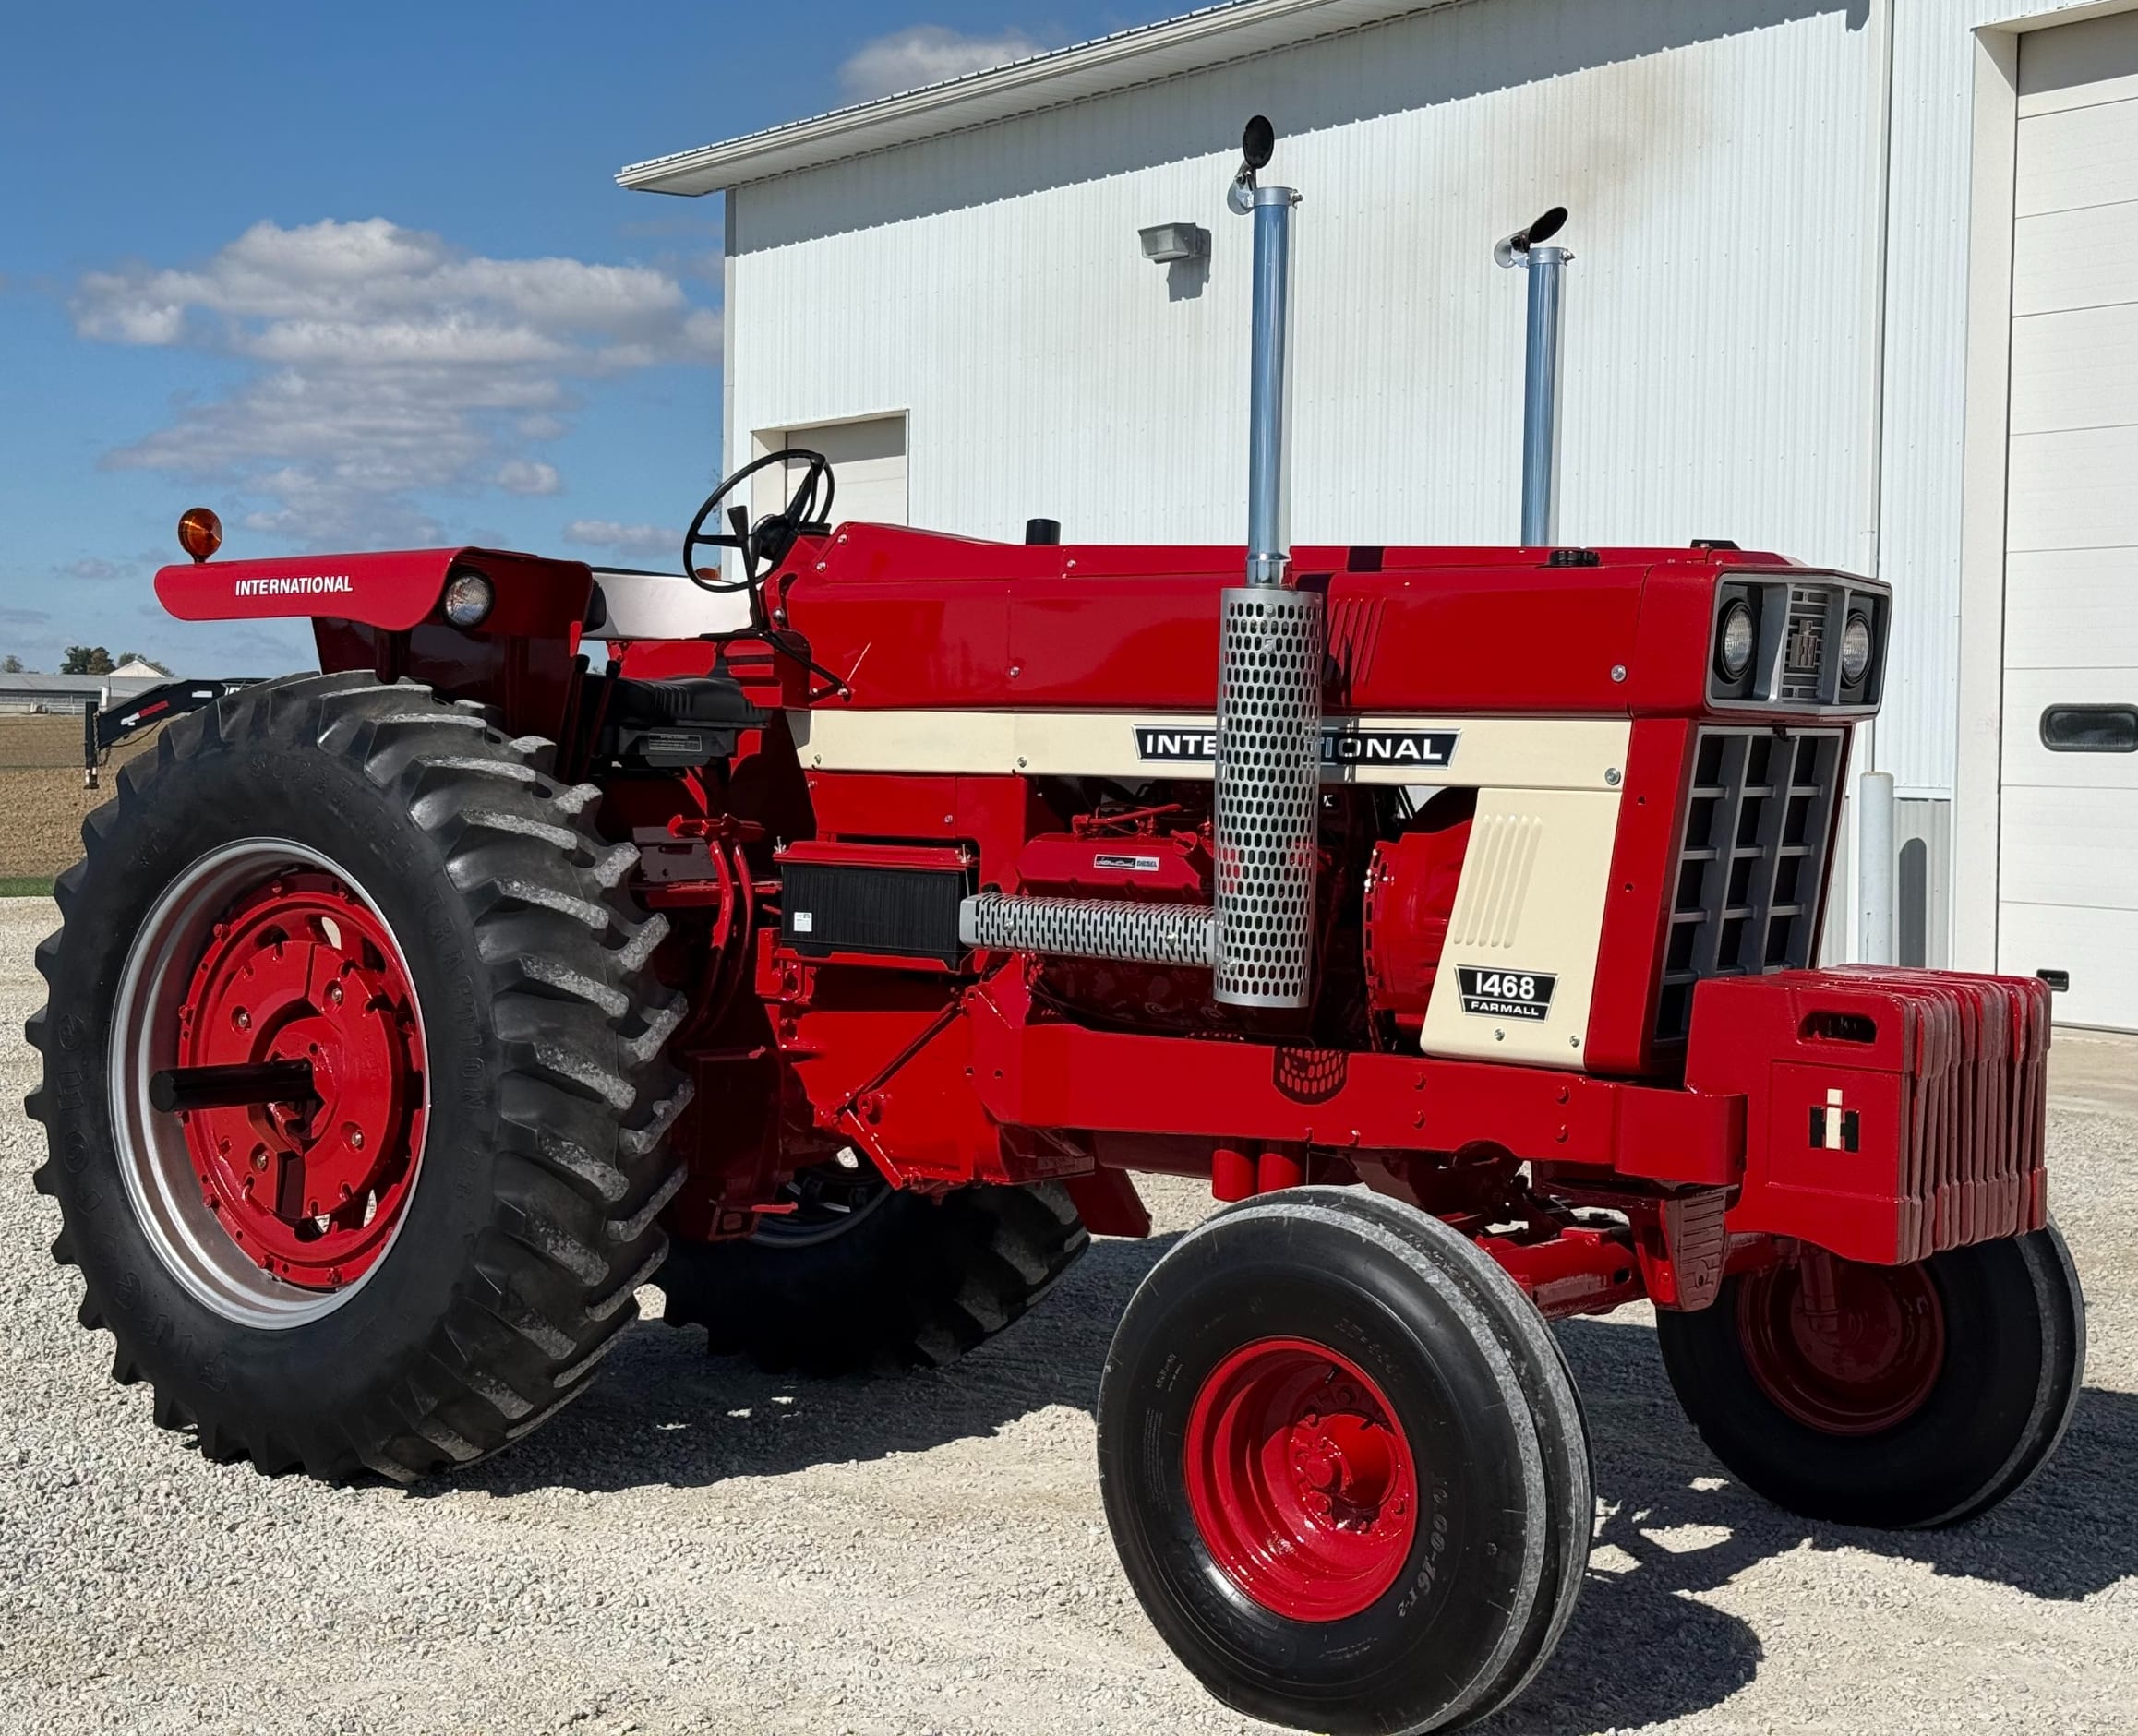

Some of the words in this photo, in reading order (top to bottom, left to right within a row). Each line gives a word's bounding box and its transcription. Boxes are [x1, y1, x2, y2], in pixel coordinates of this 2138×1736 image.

[235, 575, 354, 596] INTERNATIONAL
[1146, 734, 1443, 760] INTETIONAL
[1475, 972, 1536, 1000] 1468
[1471, 1000, 1540, 1016] FARMALL
